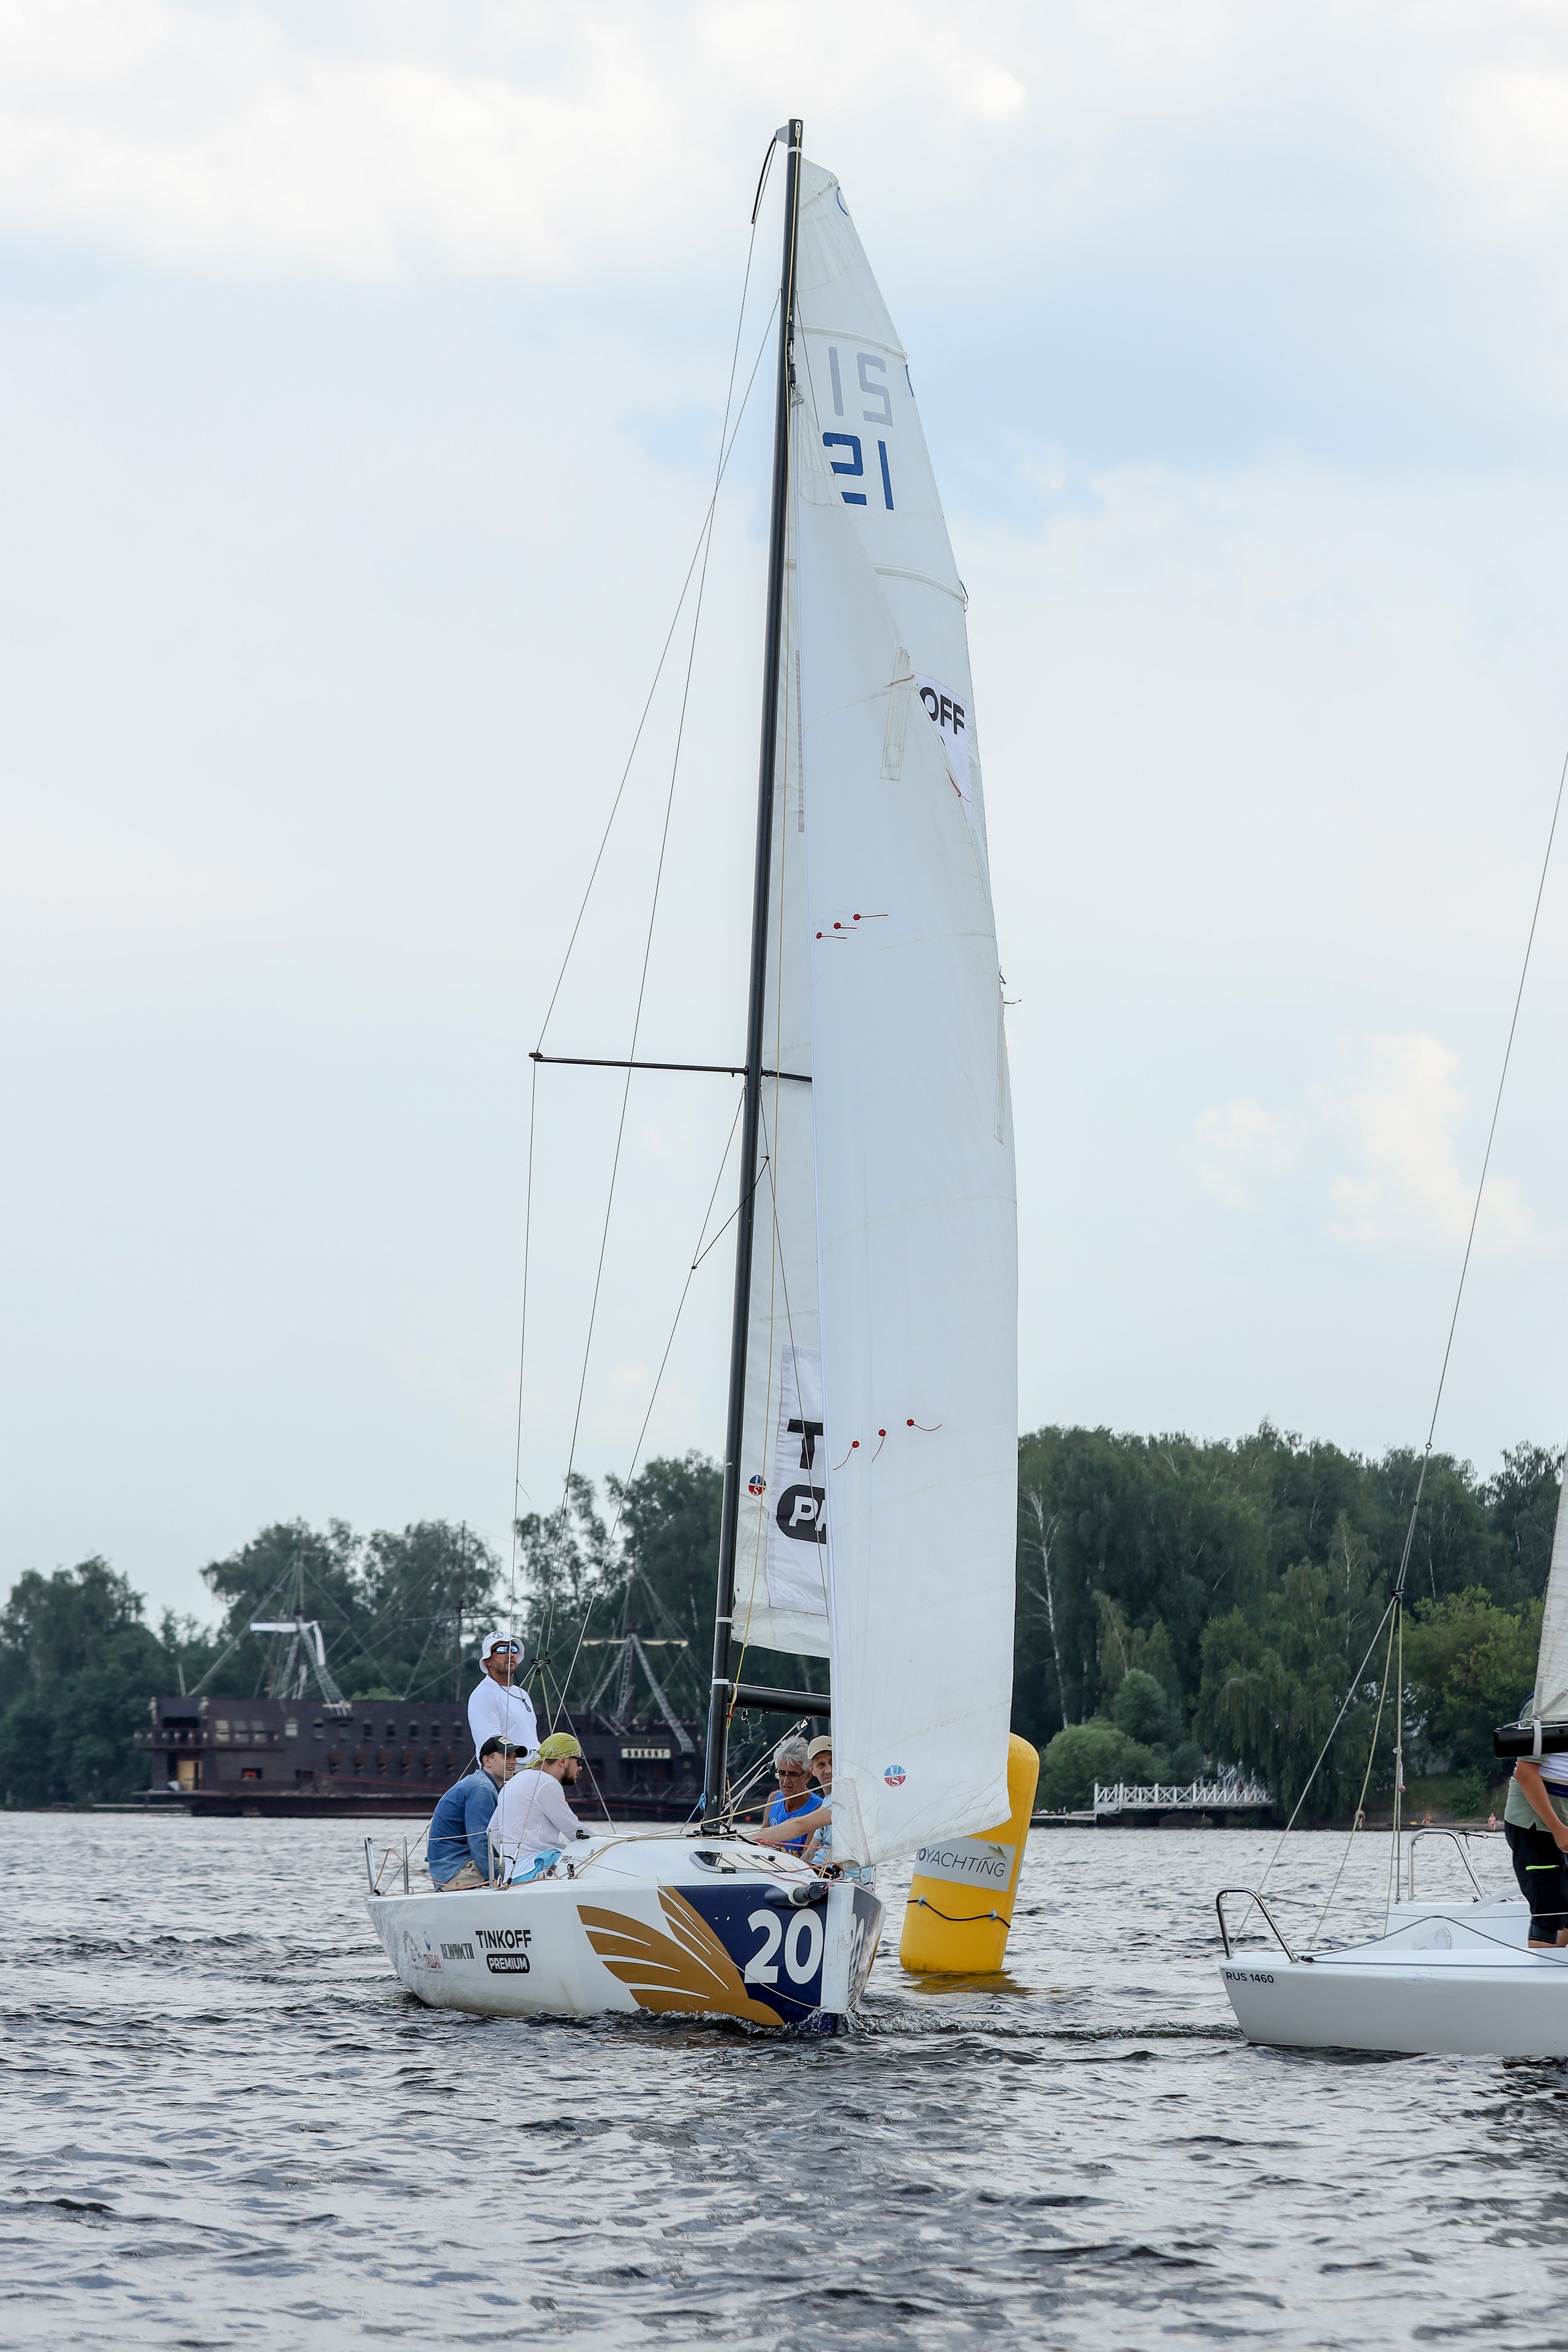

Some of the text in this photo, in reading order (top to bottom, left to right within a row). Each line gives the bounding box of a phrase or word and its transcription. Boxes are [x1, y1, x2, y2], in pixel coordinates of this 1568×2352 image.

[475, 1929, 532, 1949] TINKOFF
[744, 1908, 824, 1985] 20
[488, 1957, 527, 1970] PREMIUM
[1225, 1971, 1274, 1984] RUS 1460
